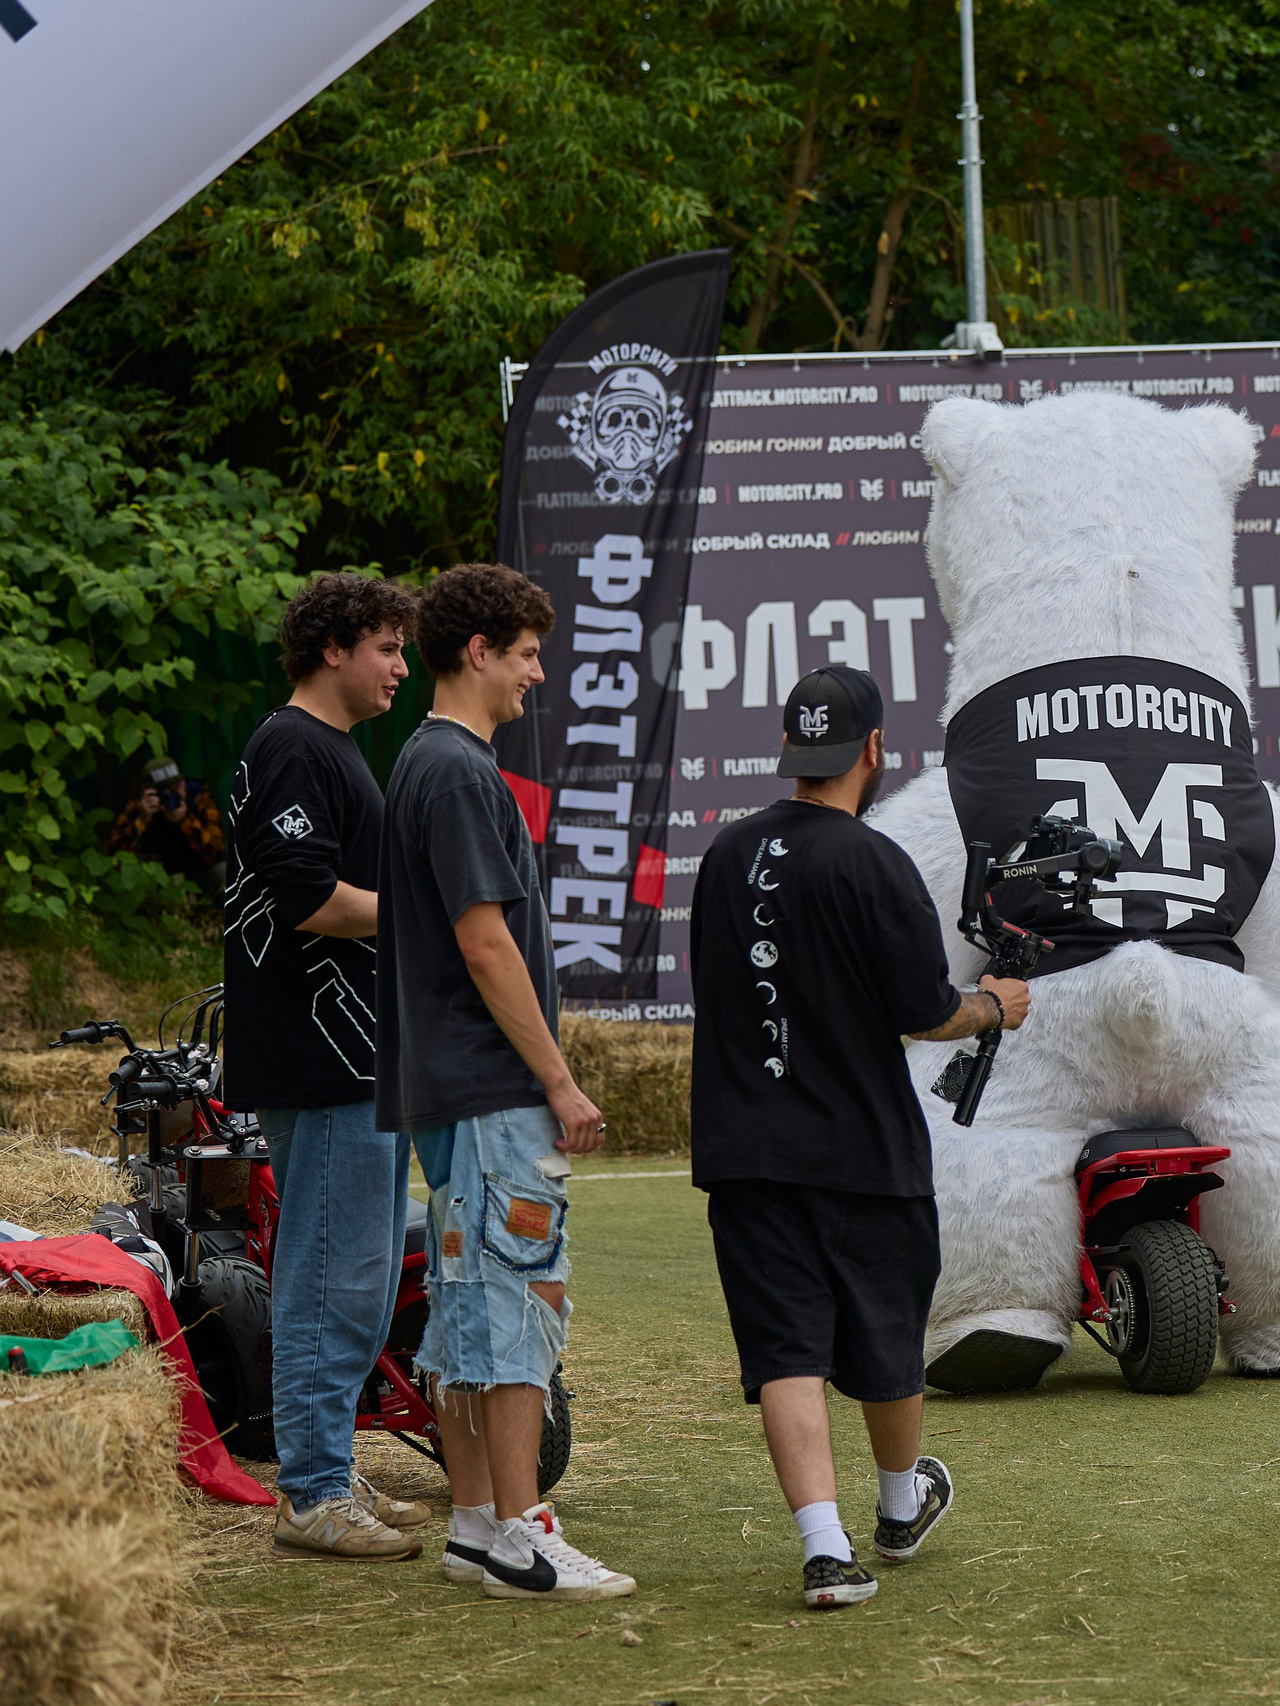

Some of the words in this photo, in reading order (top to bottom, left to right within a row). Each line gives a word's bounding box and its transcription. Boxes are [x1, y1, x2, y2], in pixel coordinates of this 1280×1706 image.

[588, 342, 679, 377] МОТОРСИТИ
[766, 436, 824, 453] ГОНКИ
[827, 431, 907, 453] ДОБРЫЙ
[738, 482, 843, 503] MOTORCITY.PRO
[766, 532, 831, 549] СКЛАД
[852, 530, 920, 546] ЛЮБИМ
[566, 533, 653, 758] ФЛЭТ
[650, 597, 926, 711] ФЛЭТ
[1016, 683, 1233, 748] MOTORCITY
[551, 781, 634, 974] ТРЕК
[1003, 864, 1038, 879] RONIN
[644, 1003, 696, 1020] СКЛА
